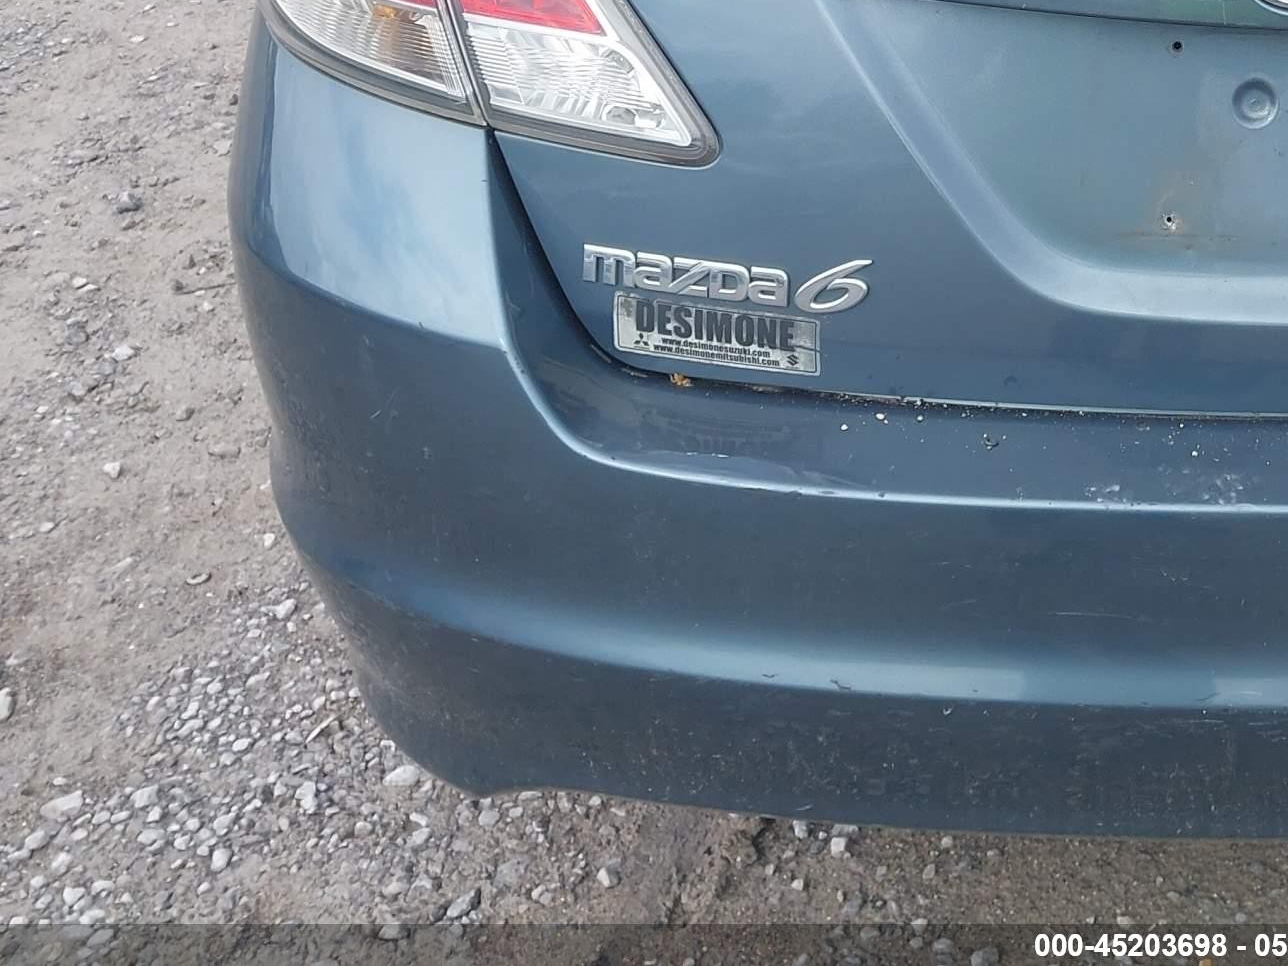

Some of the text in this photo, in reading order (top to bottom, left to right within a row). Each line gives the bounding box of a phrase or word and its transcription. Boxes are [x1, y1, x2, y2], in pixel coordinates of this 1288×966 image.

[635, 300, 796, 352] DESIMONE
[653, 344, 780, 367] www.desimonemitsubishi.com
[661, 337, 770, 358] www.desimonesuzuki.com
